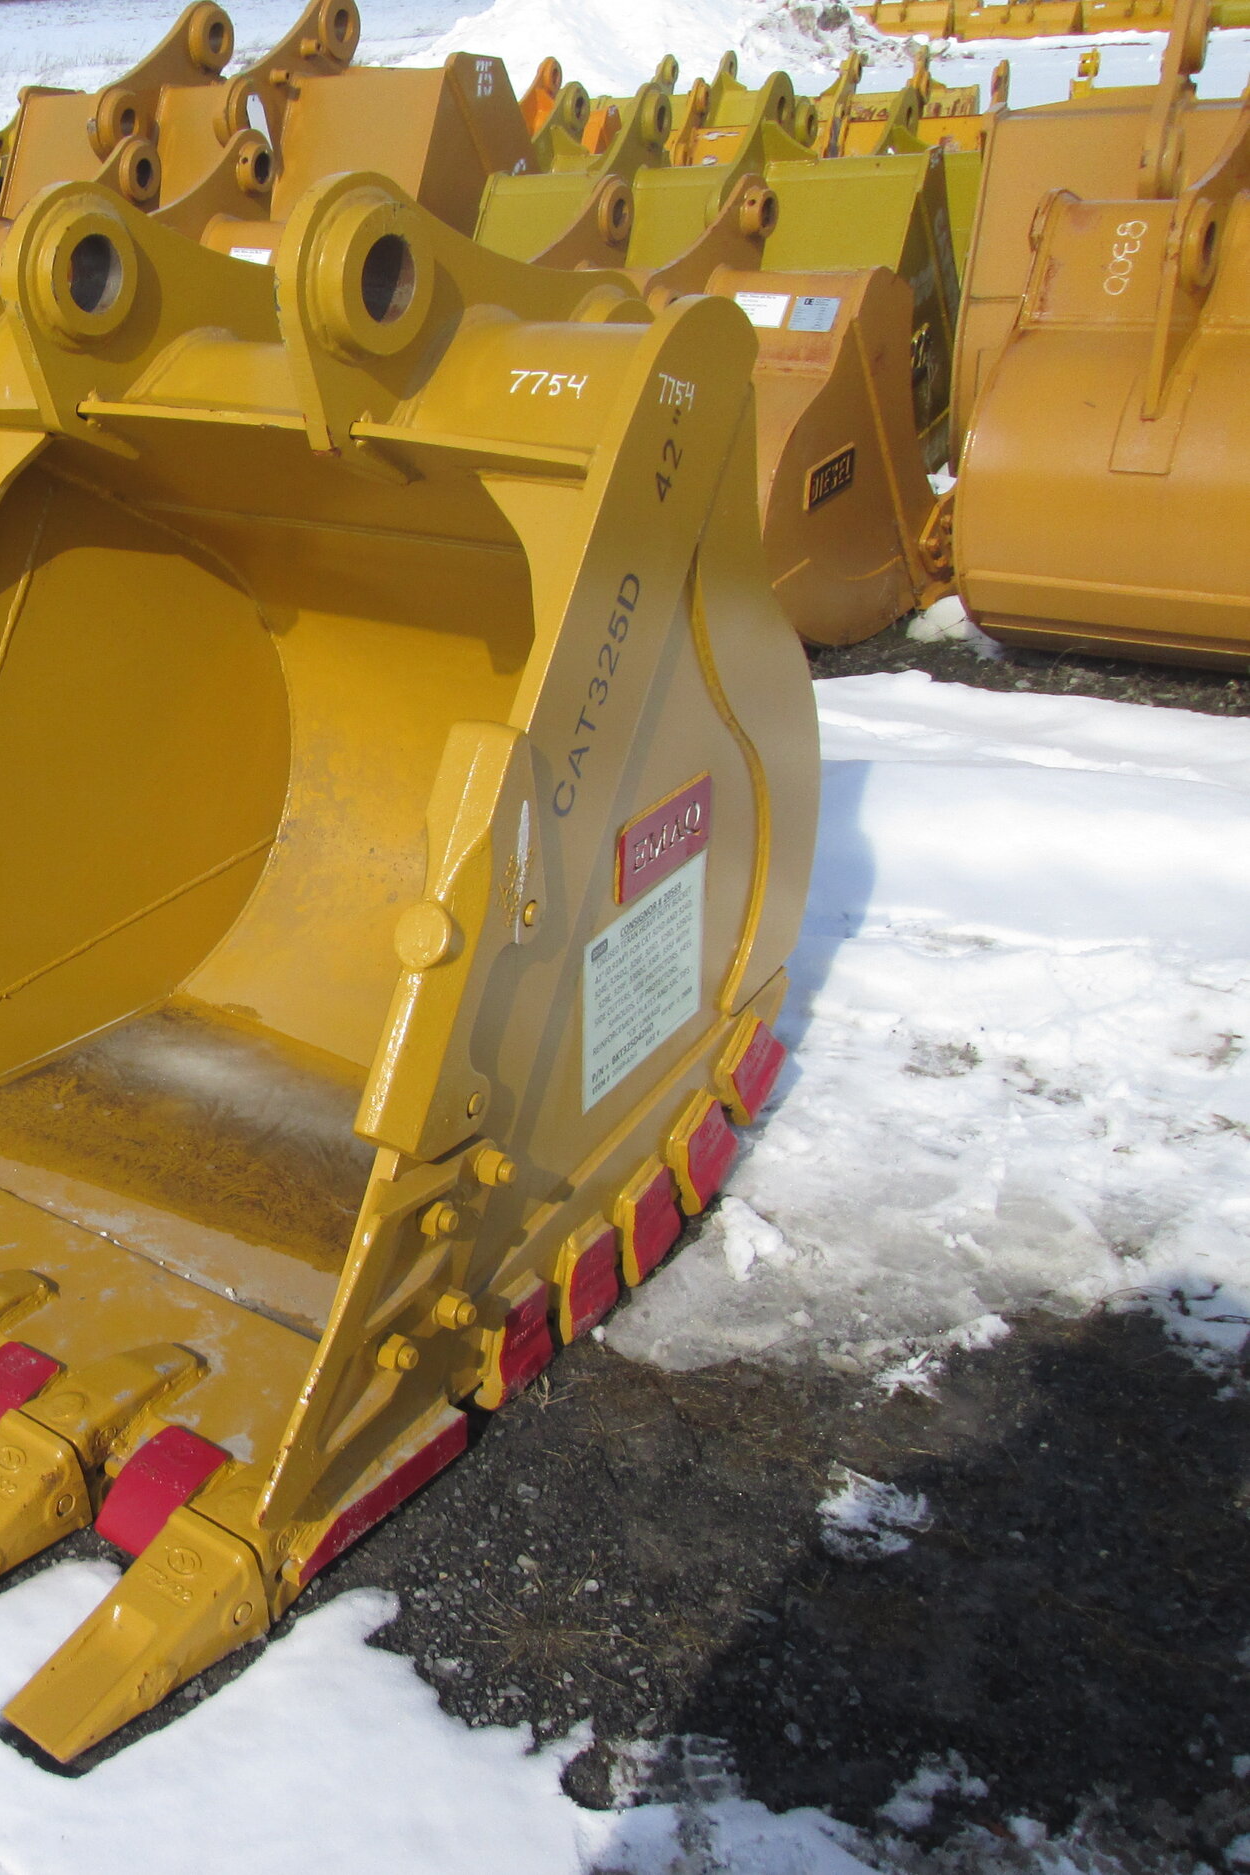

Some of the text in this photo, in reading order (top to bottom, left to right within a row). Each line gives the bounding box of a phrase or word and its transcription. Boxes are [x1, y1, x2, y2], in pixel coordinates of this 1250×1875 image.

[509, 370, 588, 399] 7754
[658, 373, 695, 408] 7754
[552, 407, 683, 817] CAT325D 42"
[633, 801, 702, 874] EMAQ
[620, 900, 656, 938] CONSIGNOR
[658, 896, 661, 908] #
[620, 928, 637, 950] TERAN
[639, 913, 656, 936] HEAVY
[657, 902, 670, 921] DUTY
[630, 940, 640, 957] FOR
[641, 931, 651, 947] CAT
[666, 910, 677, 927] AND
[592, 1011, 636, 1057] REINFORCEMENT
[638, 994, 656, 1018] PLATES
[657, 984, 667, 1002] AND
[594, 1009, 606, 1028] SIDE
[632, 978, 643, 996] SIDE
[639, 1003, 660, 1029] LINKAGE
[592, 1063, 603, 1084] P/N
